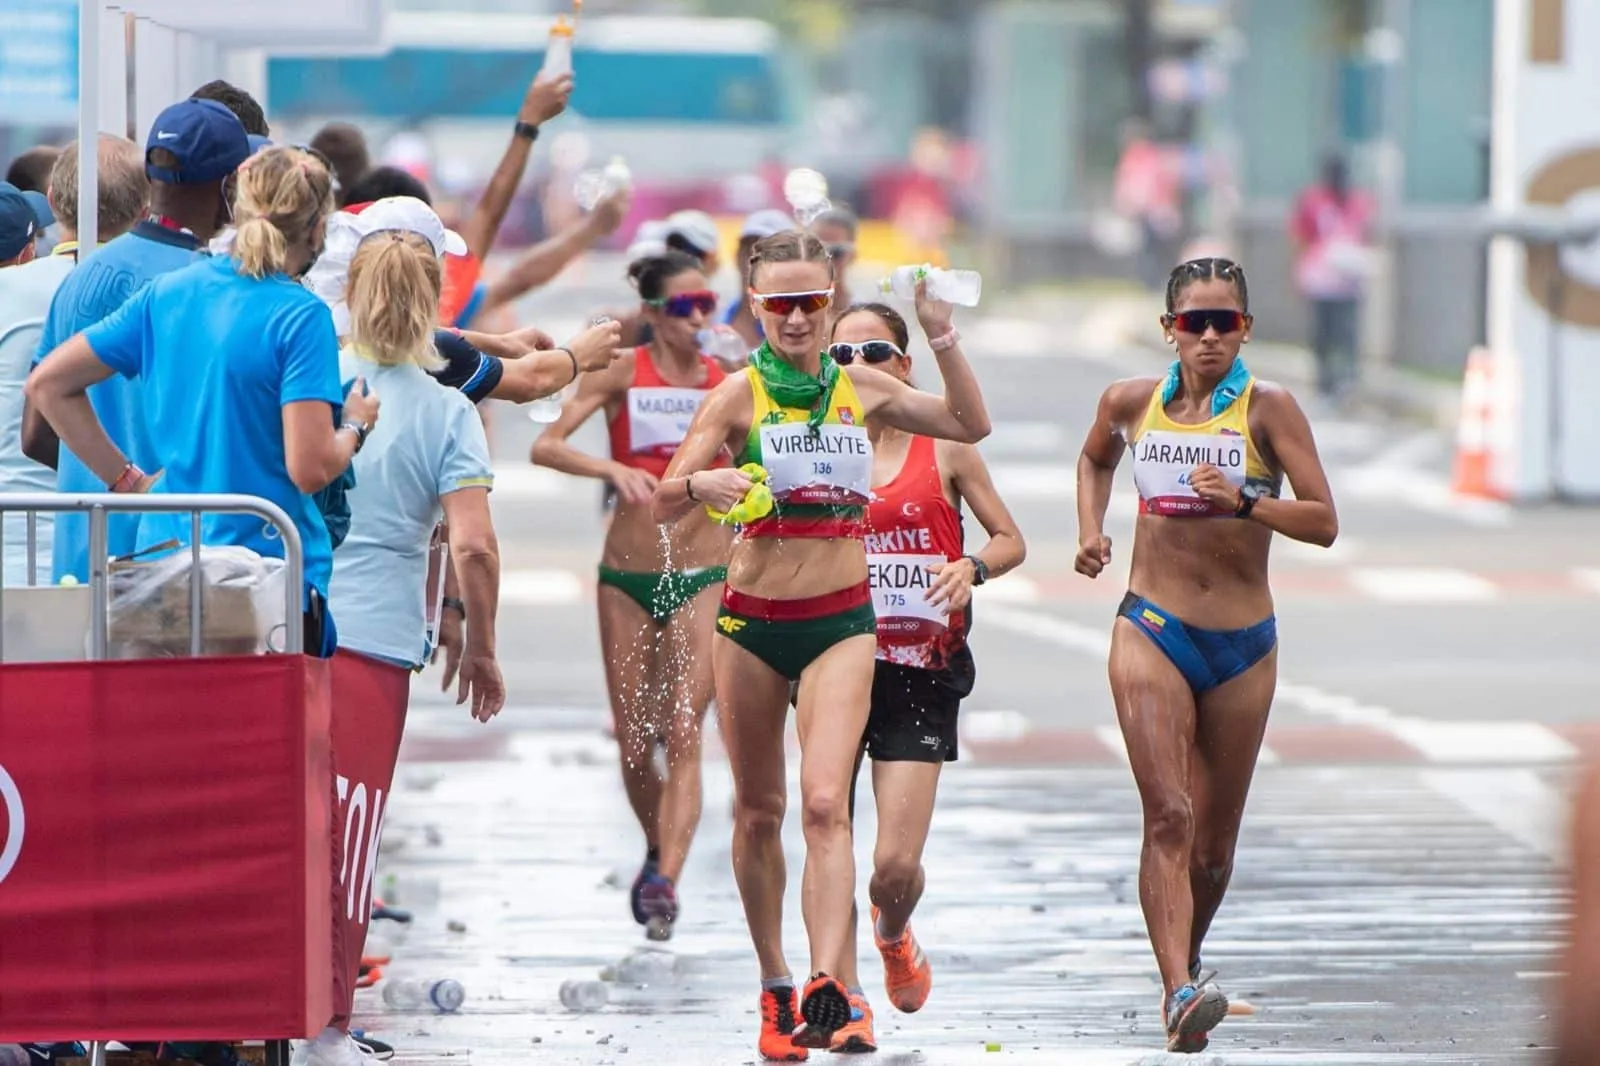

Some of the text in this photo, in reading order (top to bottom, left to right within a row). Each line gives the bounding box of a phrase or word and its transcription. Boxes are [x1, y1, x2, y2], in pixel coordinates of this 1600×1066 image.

[637, 398, 703, 414] MADAR
[770, 433, 867, 455] VIRBALYTE
[1140, 443, 1241, 467] JARAMILLO
[812, 462, 833, 475] 136
[1159, 501, 1177, 509] TOKYO
[884, 594, 906, 607] 175
